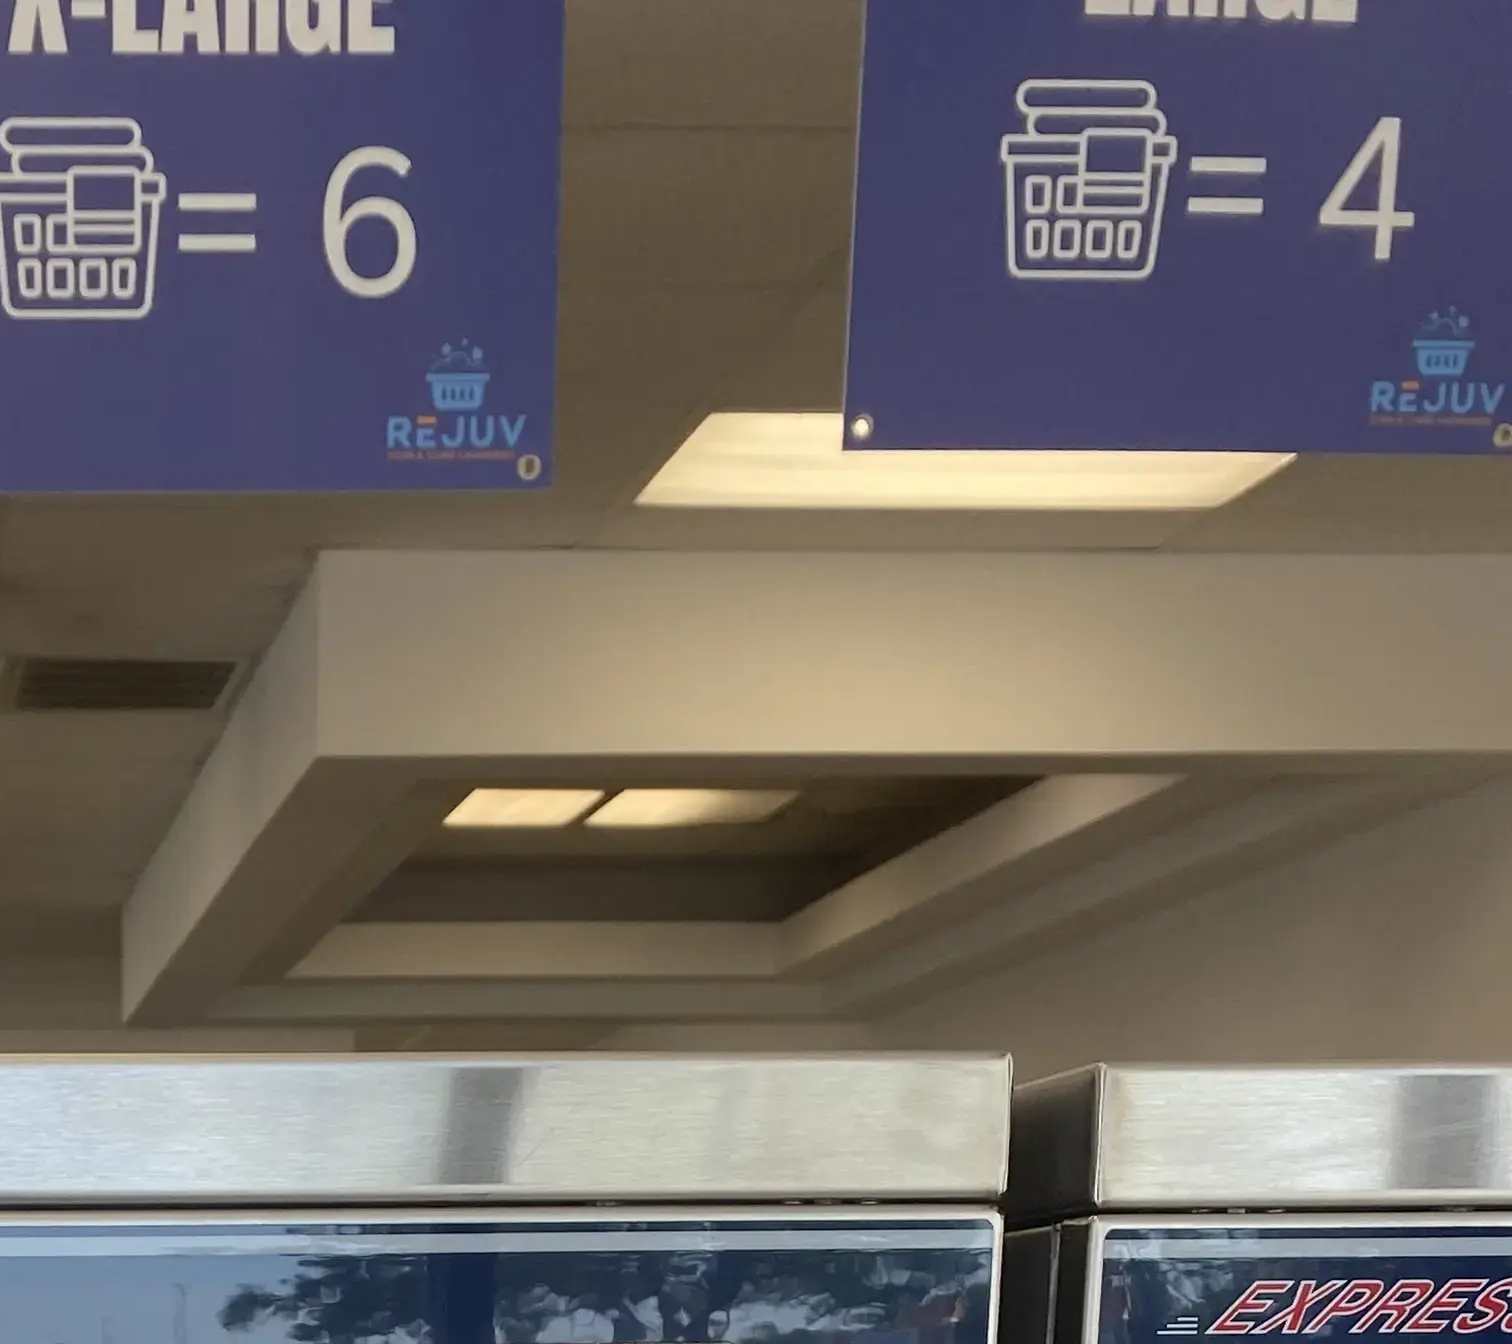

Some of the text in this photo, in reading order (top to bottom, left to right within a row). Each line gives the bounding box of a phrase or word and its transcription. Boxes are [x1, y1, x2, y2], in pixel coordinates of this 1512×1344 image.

[323, 146, 417, 298] 6
[1319, 116, 1415, 260] 4
[1206, 1278, 1512, 1335] EXPRES
